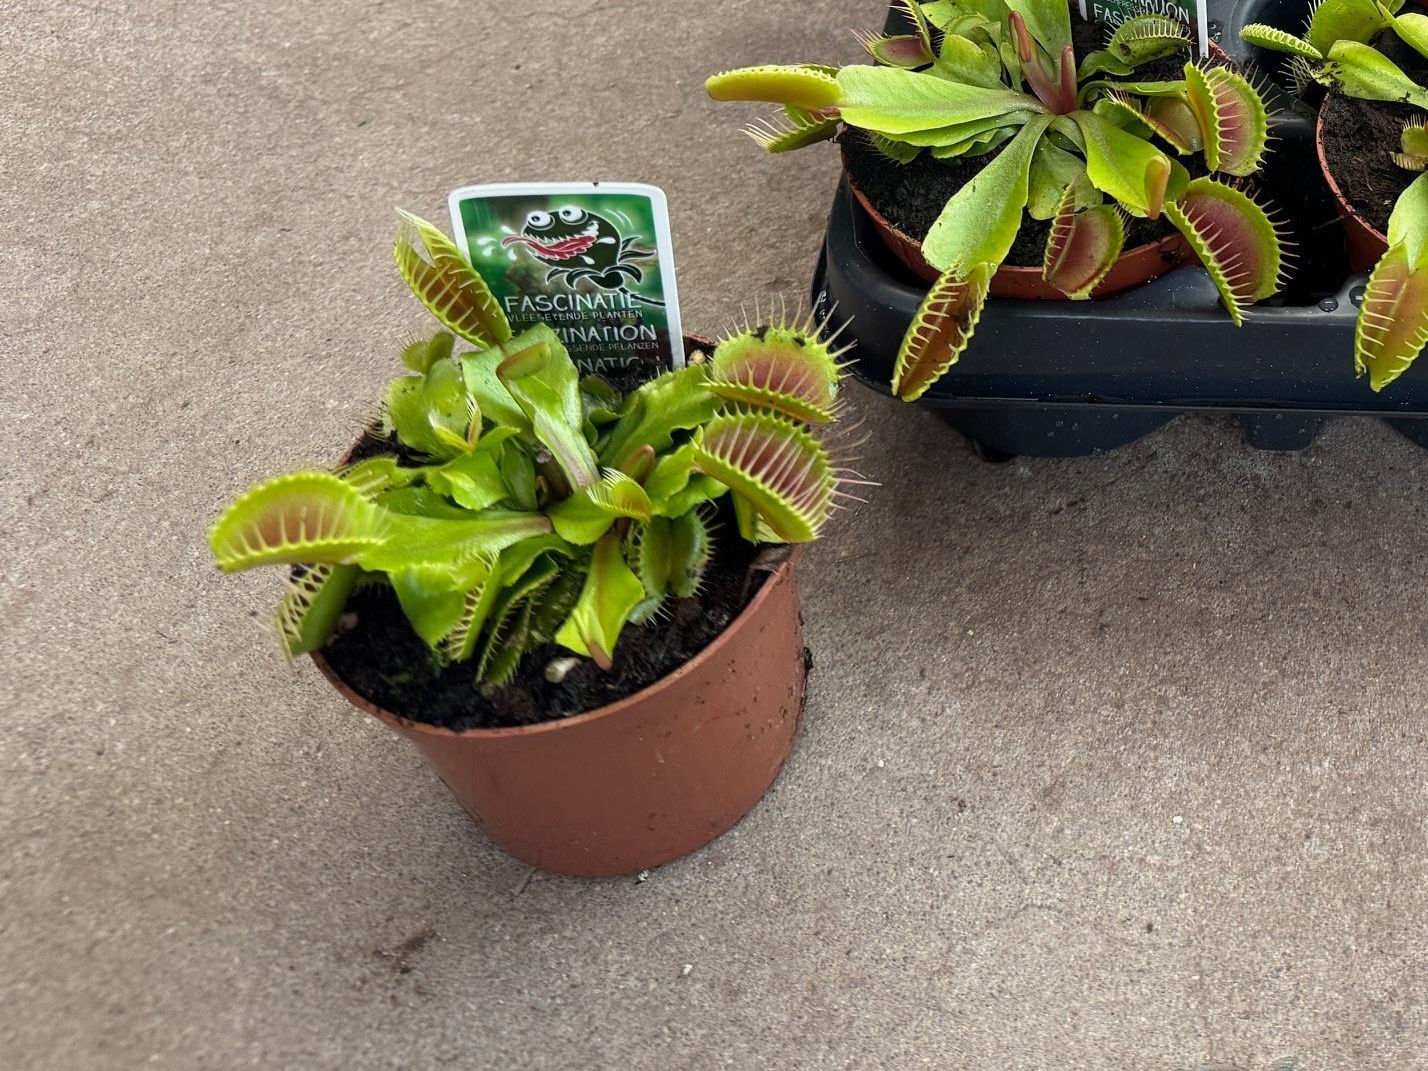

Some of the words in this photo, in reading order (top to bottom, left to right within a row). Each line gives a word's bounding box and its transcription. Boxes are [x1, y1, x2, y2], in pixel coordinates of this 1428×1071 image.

[504, 292, 642, 312] FASCINATIE
[593, 310, 643, 320] PLANTEN
[609, 341, 659, 351] PFLANZEN
